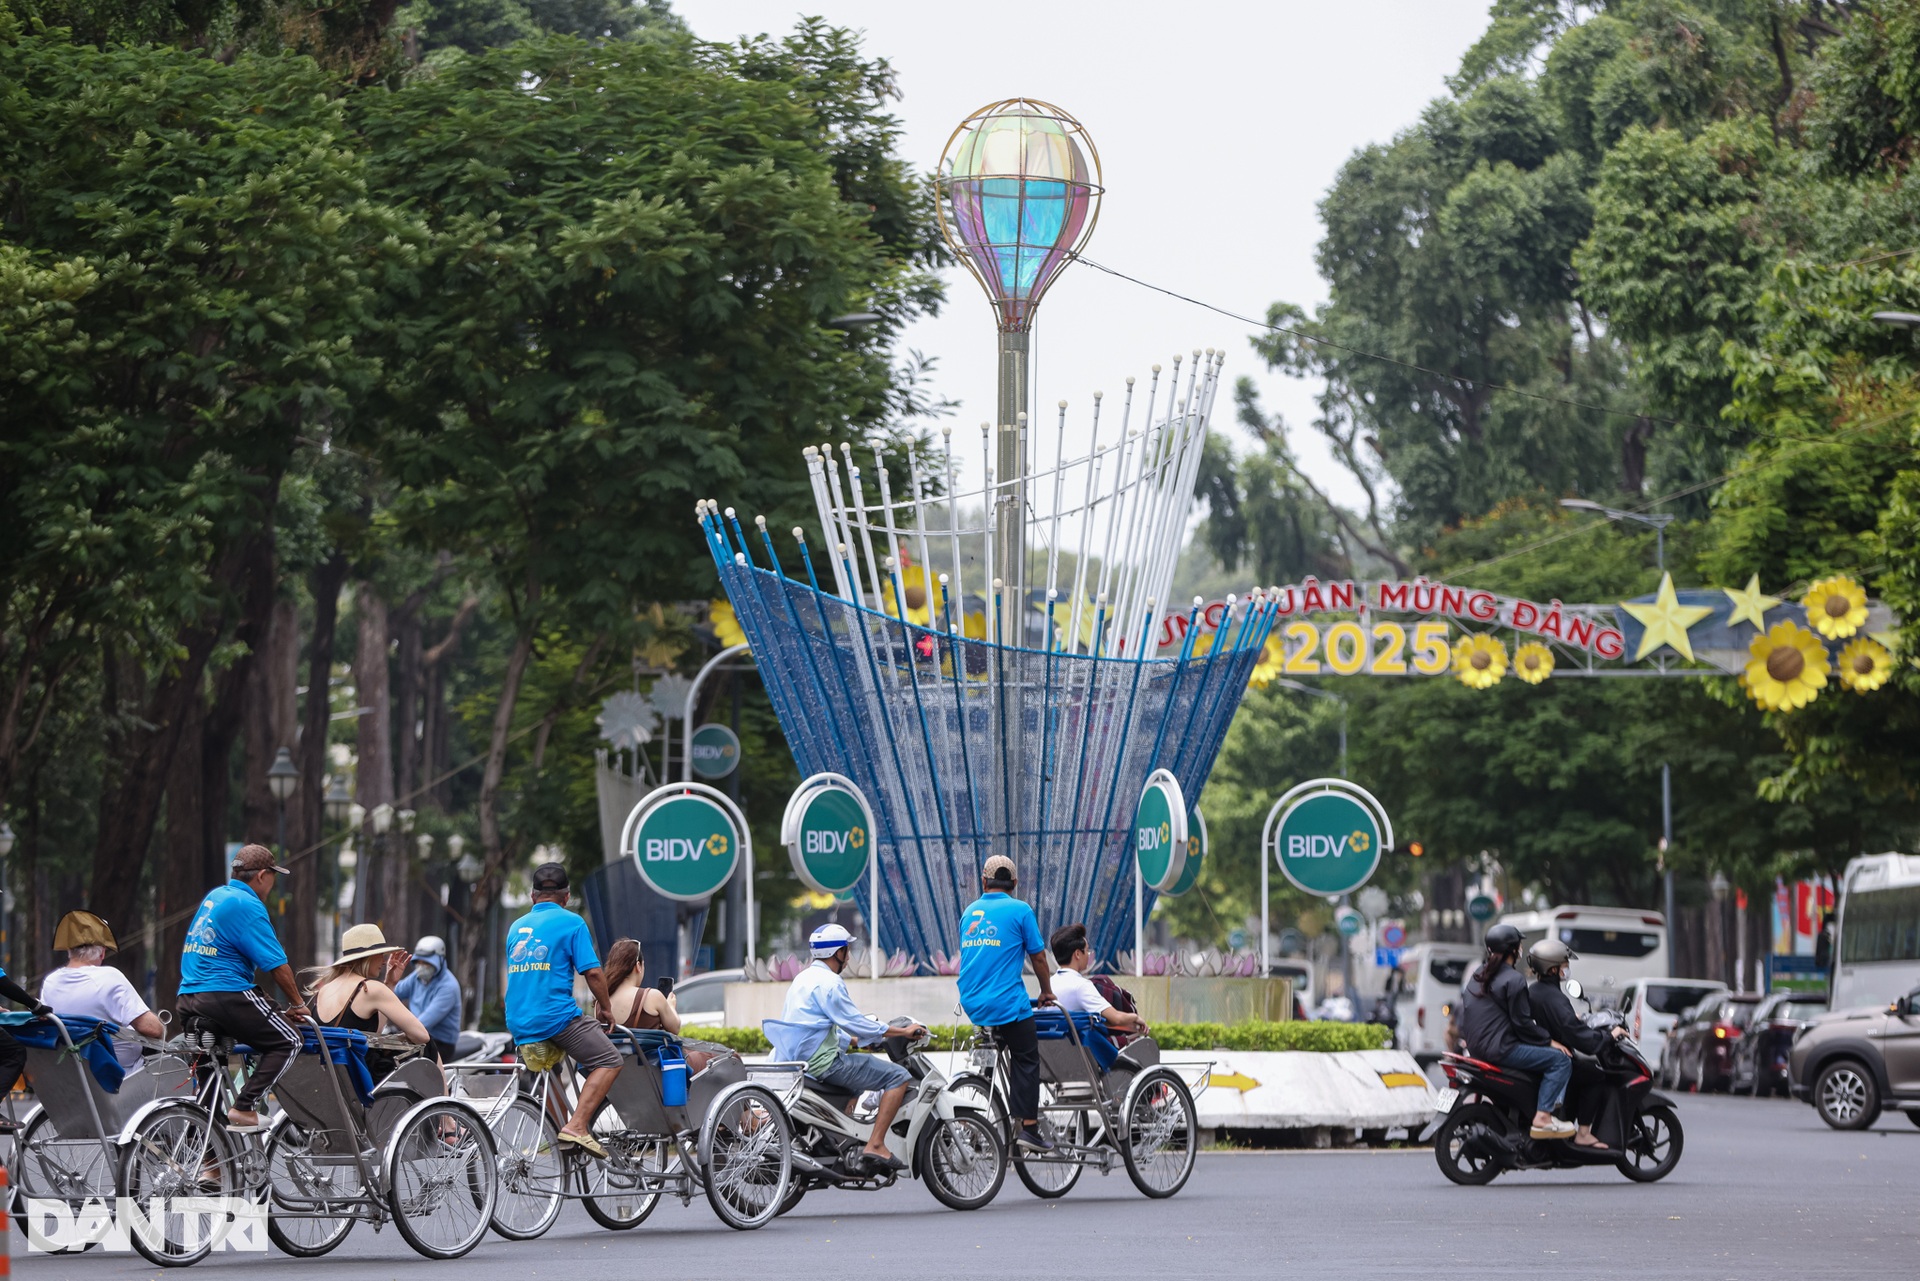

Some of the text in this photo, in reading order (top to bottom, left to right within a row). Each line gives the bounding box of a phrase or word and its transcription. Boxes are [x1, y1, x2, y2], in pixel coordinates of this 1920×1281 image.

[1247, 578, 1366, 617] UÂN,
[1379, 577, 1497, 620] MỪNG
[1512, 600, 1624, 658] ĐẢNG
[1285, 622, 1449, 674] 2025
[693, 744, 723, 759] BIDV
[646, 838, 706, 861] BIDV
[806, 830, 849, 853] BIDV
[1139, 827, 1161, 850] BIDV
[1288, 835, 1348, 857] BIDV
[530, 962, 551, 971] TOUR
